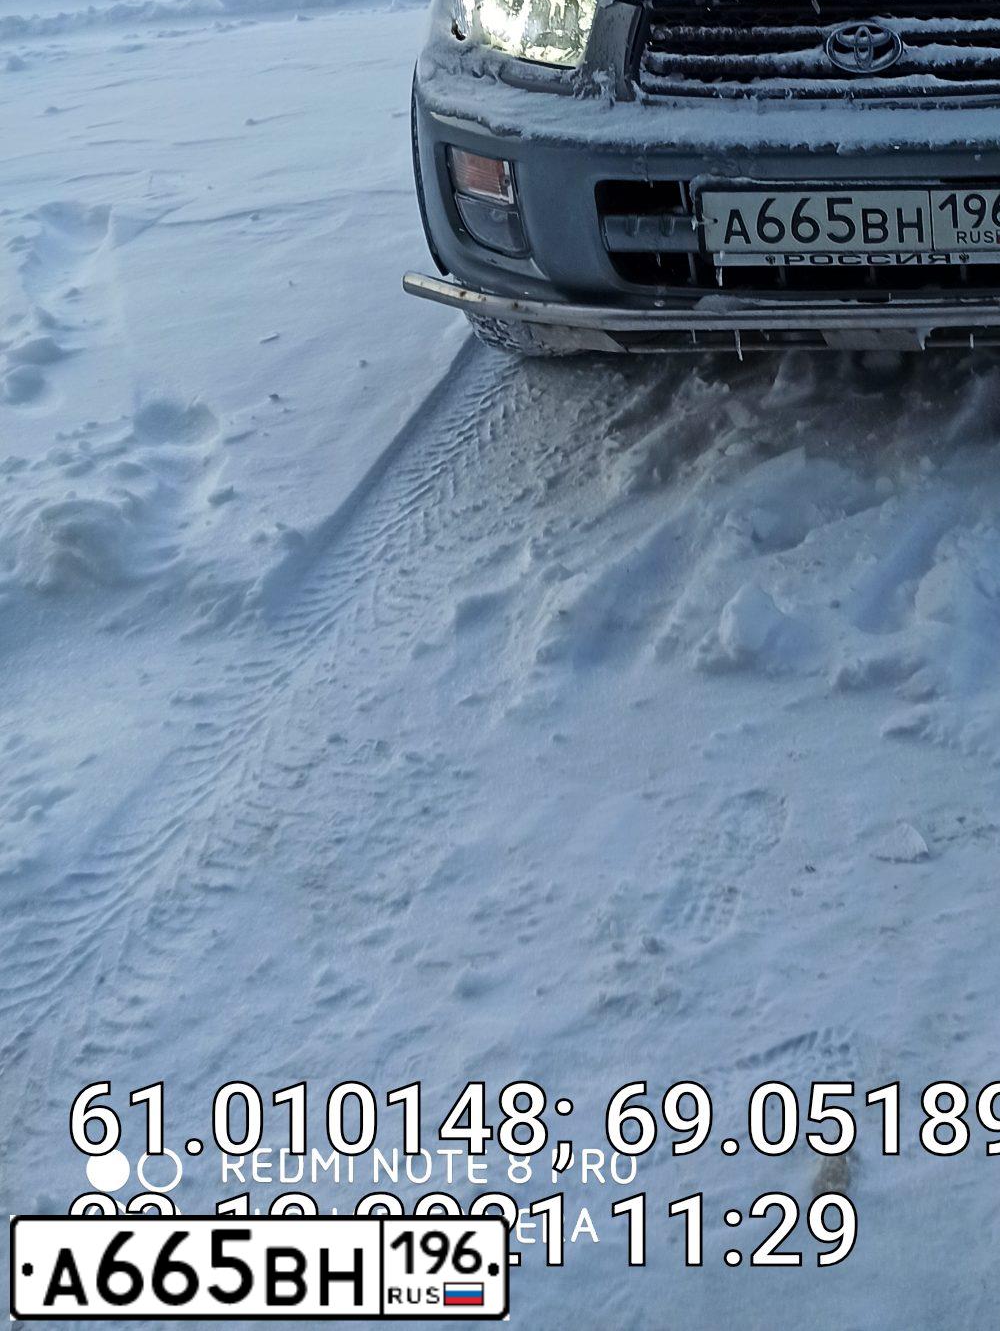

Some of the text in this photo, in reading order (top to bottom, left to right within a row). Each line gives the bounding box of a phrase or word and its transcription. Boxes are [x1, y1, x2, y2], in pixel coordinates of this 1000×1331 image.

[723, 197, 925, 245] А665ВН
[956, 230, 994, 244] RUS
[784, 253, 952, 265] РОССИЯ
